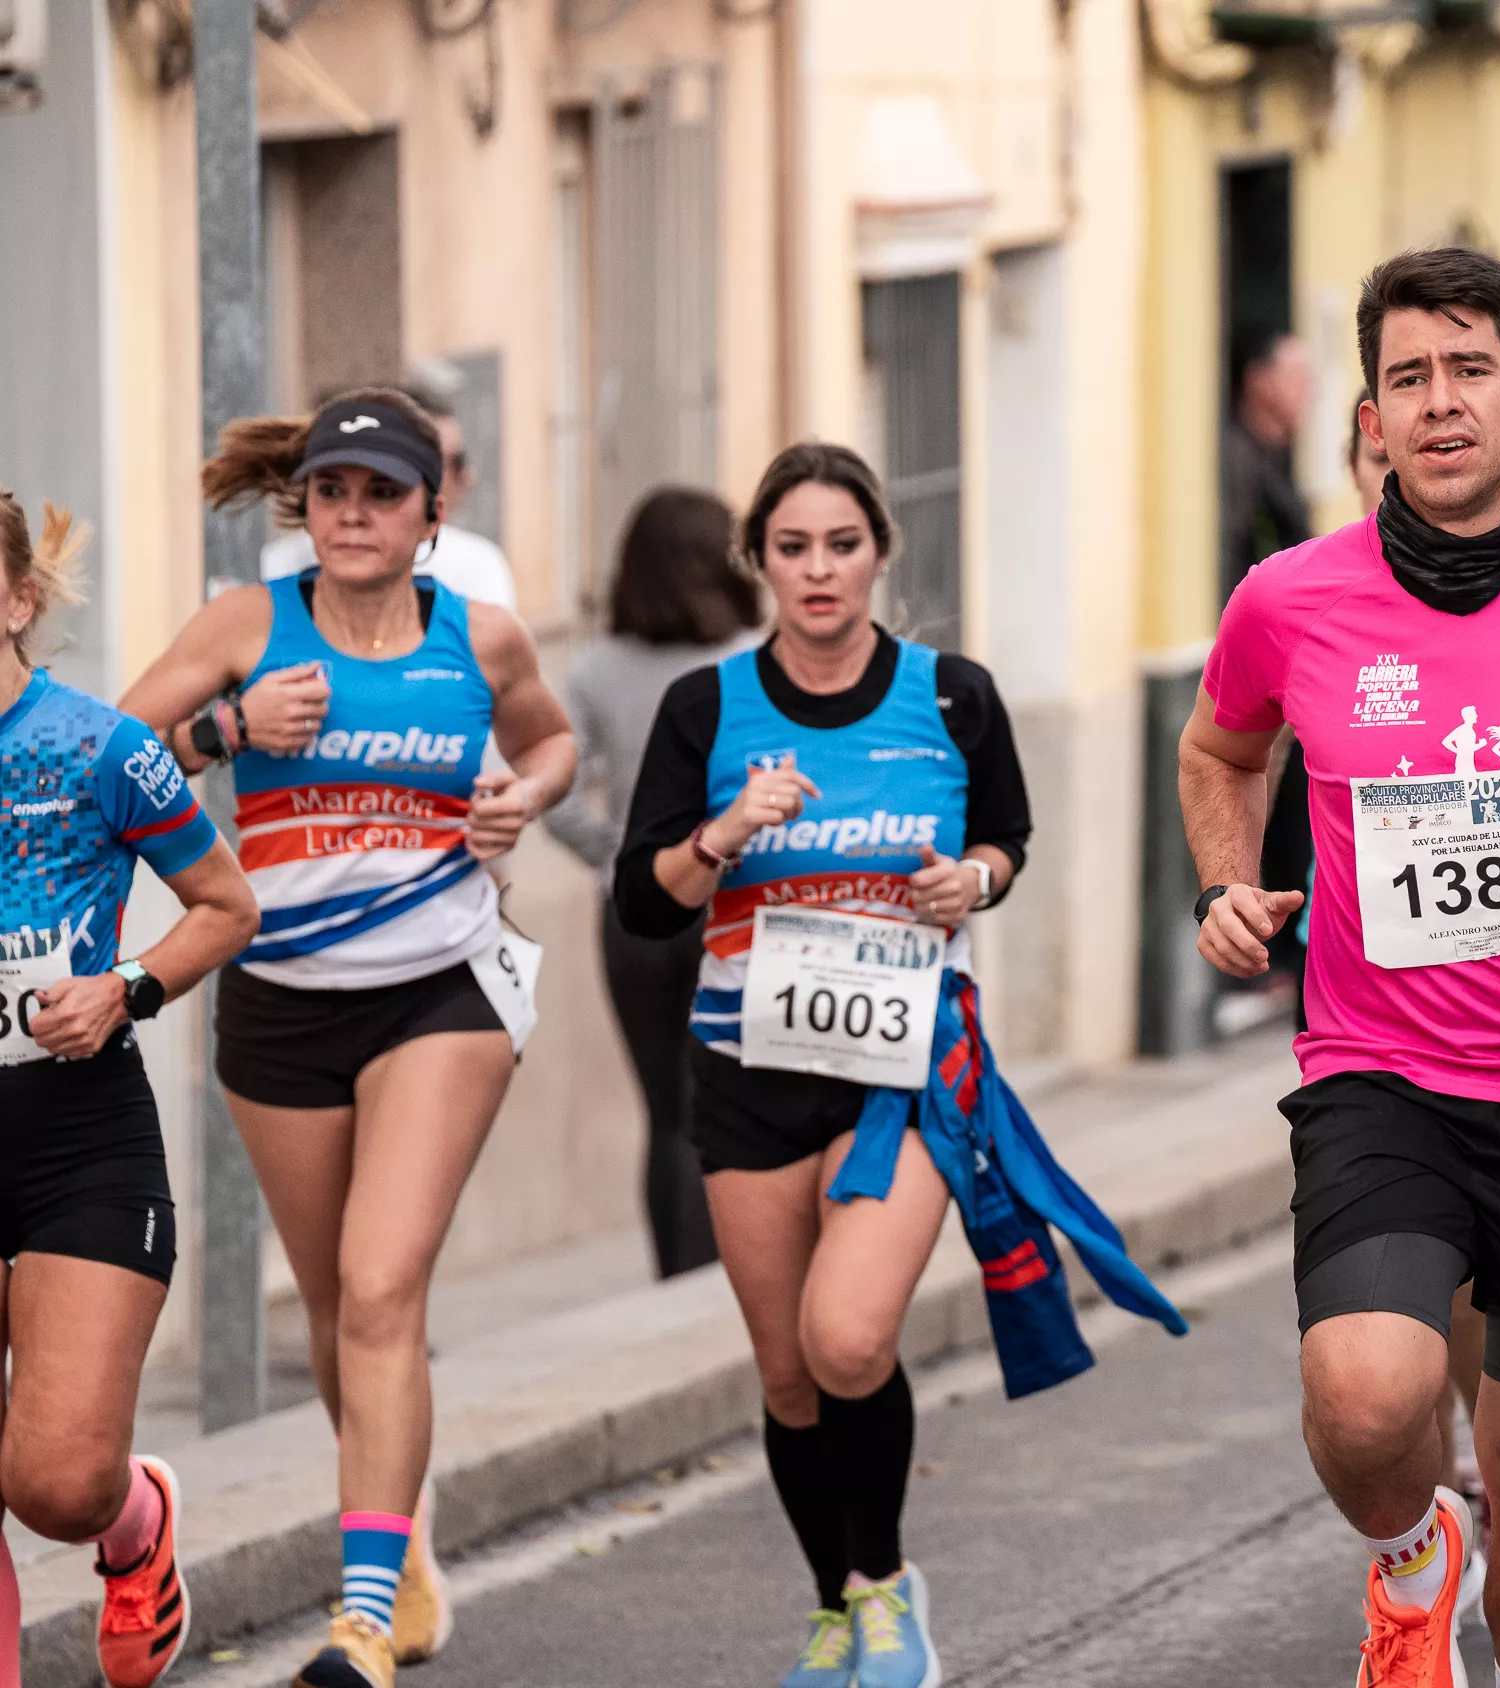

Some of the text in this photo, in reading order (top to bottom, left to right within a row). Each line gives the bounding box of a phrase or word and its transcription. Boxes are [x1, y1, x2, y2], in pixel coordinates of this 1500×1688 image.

[1376, 653, 1399, 666] XXV
[1358, 664, 1418, 682] CARRERA
[1355, 680, 1420, 693] POPULAR
[1352, 700, 1420, 714] LUCENA
[124, 739, 160, 780] Club
[1359, 780, 1466, 797] CIRCUITO PROVINCIAL DE
[289, 787, 436, 819] Maratón
[1360, 790, 1466, 806] CARRERAS POPULARES
[12, 798, 75, 816] enerplus
[1412, 805, 1423, 813] DE
[305, 824, 424, 855] Lucena
[1412, 837, 1430, 847] XXV
[1447, 834, 1478, 843] CIUDAD
[1479, 832, 1491, 840] DE
[1431, 847, 1448, 856] POR
[1449, 846, 1461, 854] LA
[1428, 926, 1482, 940] ALEJANDRO
[775, 982, 909, 1042] 1003
